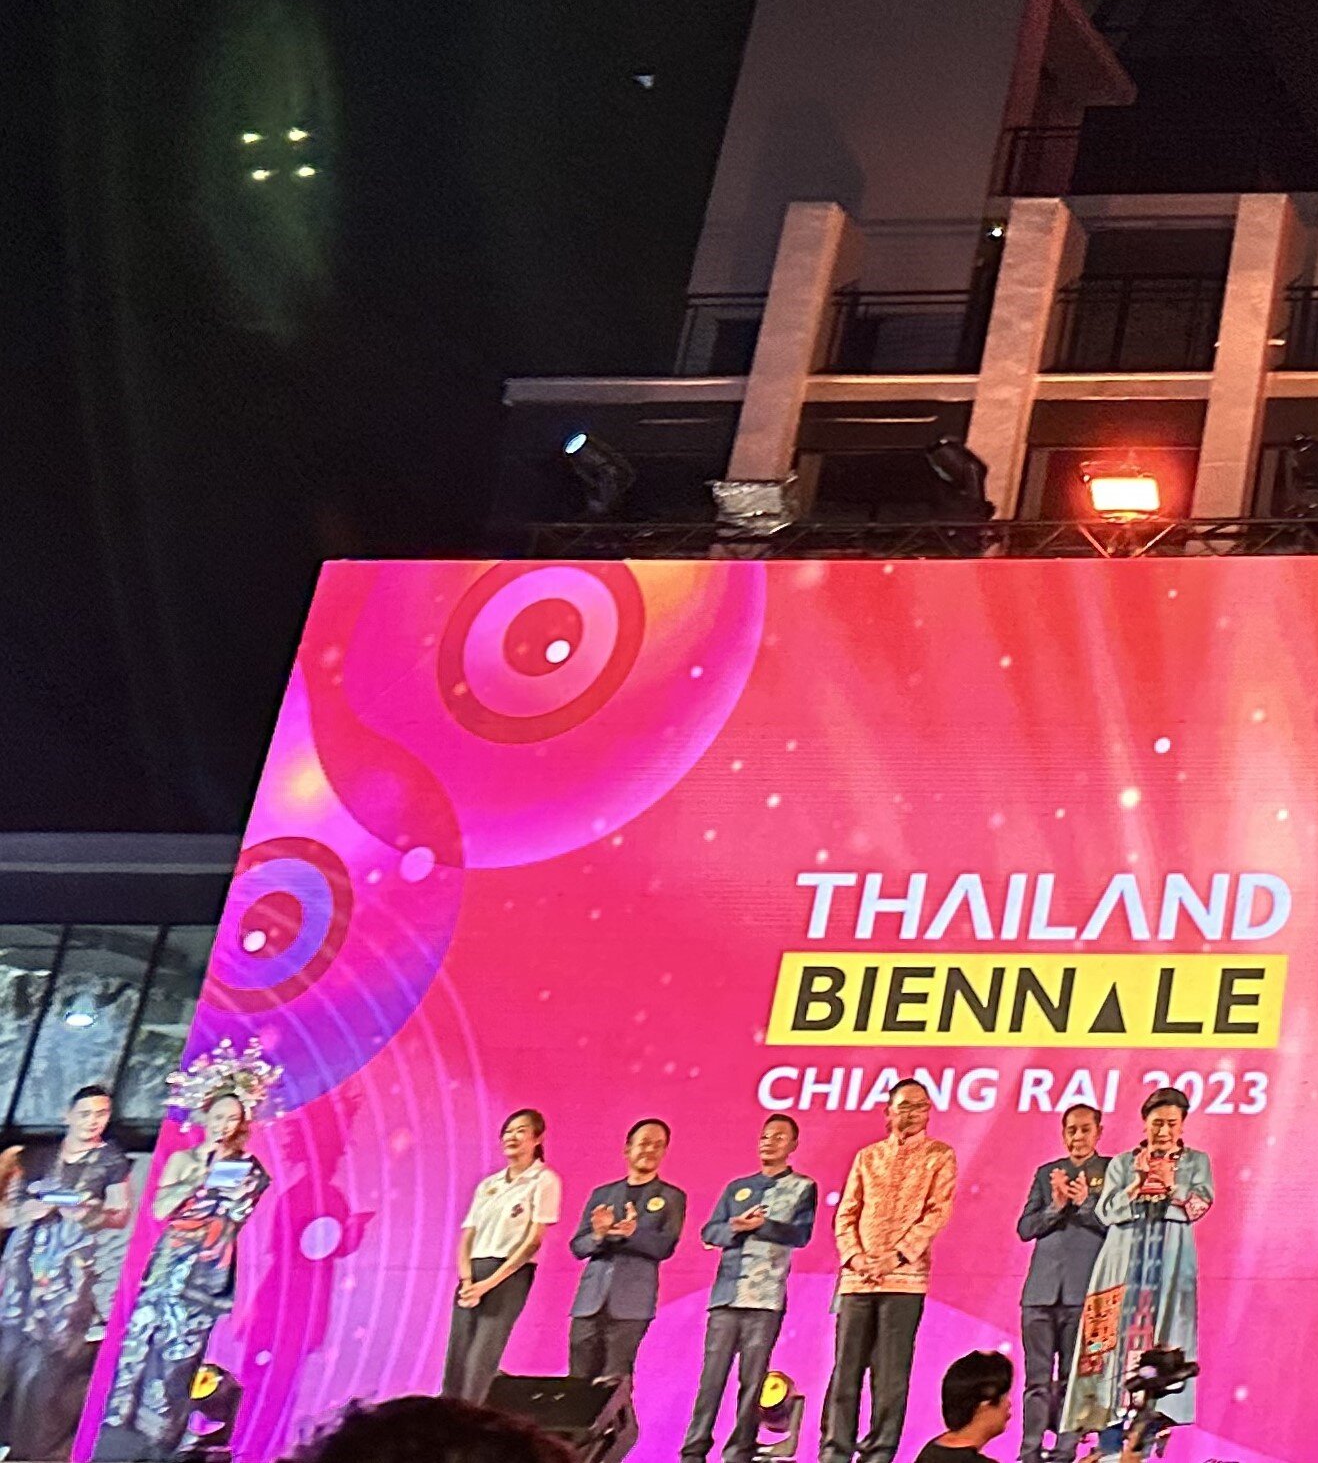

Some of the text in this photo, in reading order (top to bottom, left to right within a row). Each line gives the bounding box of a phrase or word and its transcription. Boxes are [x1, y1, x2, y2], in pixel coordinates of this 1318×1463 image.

[796, 873, 1292, 941] THAILAND
[790, 966, 1266, 1035] BIENNALE
[757, 1066, 1000, 1113] CHIANG
[1017, 1068, 1120, 1114] RAI
